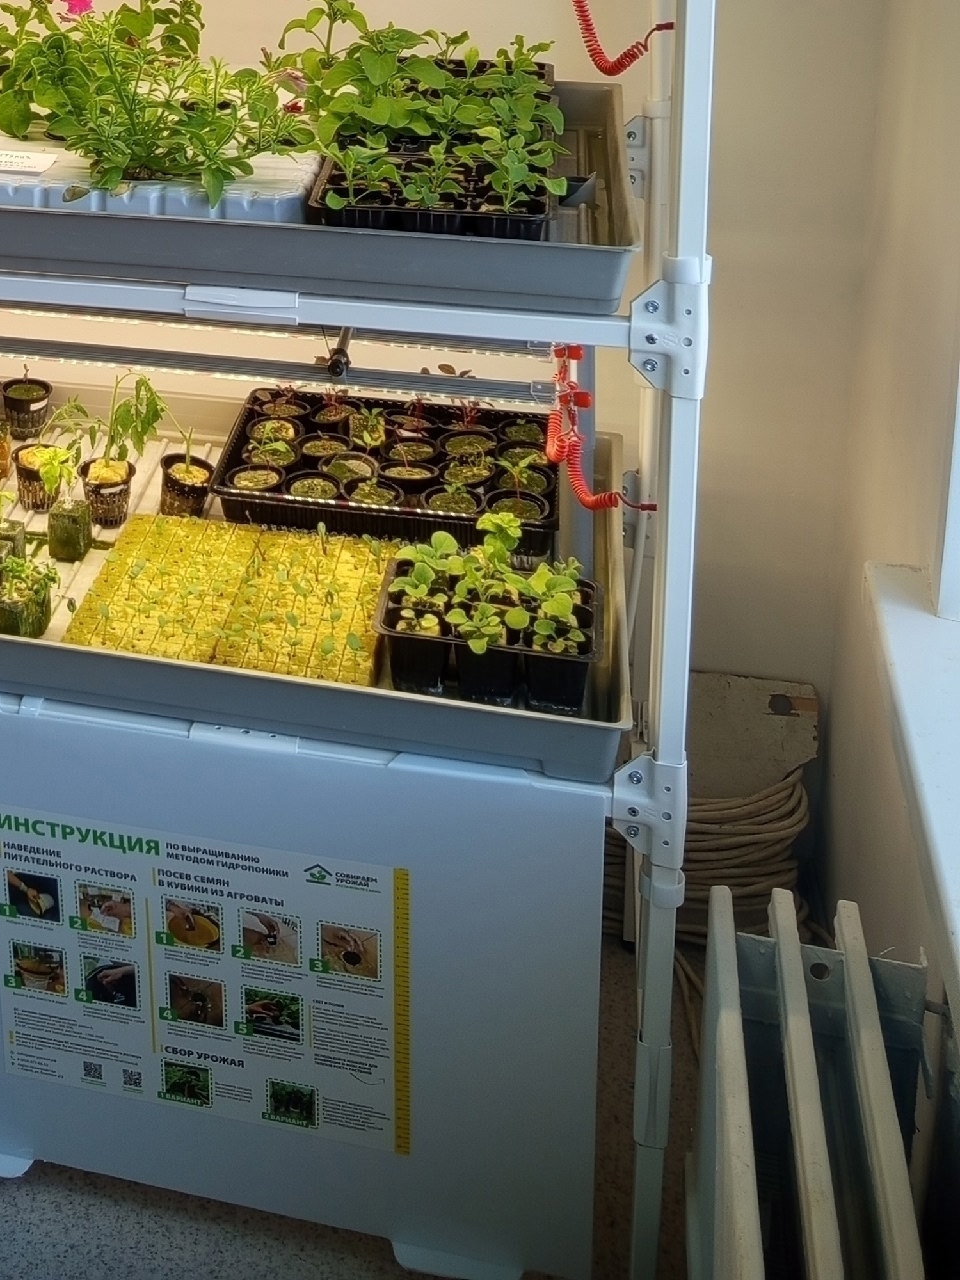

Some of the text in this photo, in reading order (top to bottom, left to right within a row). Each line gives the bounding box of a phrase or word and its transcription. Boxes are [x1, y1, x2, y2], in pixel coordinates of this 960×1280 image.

[3, 841, 62, 858] НАВЕДЕНИЕ
[165, 842, 260, 864] ПО ВЫРАЩИВАНИЮ
[3, 851, 137, 882] ПИТАТЕЛЬНОГО РАСТВОРА
[166, 851, 289, 878] МЕТОДОМ ГИДРОПОНИКИ
[157, 868, 230, 887] ПОСЕВ СЕМЯН
[335, 871, 378, 883] СОБИРАЕМ
[335, 877, 370, 888] УРОЖАЙ
[158, 878, 285, 907] В КУБИКИ ИЗ АГРОВАТЫ
[3, 906, 11, 916] 1
[73, 920, 82, 929] 2
[160, 933, 167, 943] 1
[235, 948, 245, 958] 2
[313, 961, 323, 971] 3
[7, 976, 16, 987] 3
[78, 991, 87, 1001] 4
[163, 1009, 172, 1020] 4
[238, 1024, 247, 1034] 5
[165, 1045, 194, 1058] СБОР
[195, 1050, 245, 1068] УРОЖАЯ
[165, 1093, 202, 1106] ВАРИАНТ
[269, 1114, 308, 1127] ВАРИАНТ
